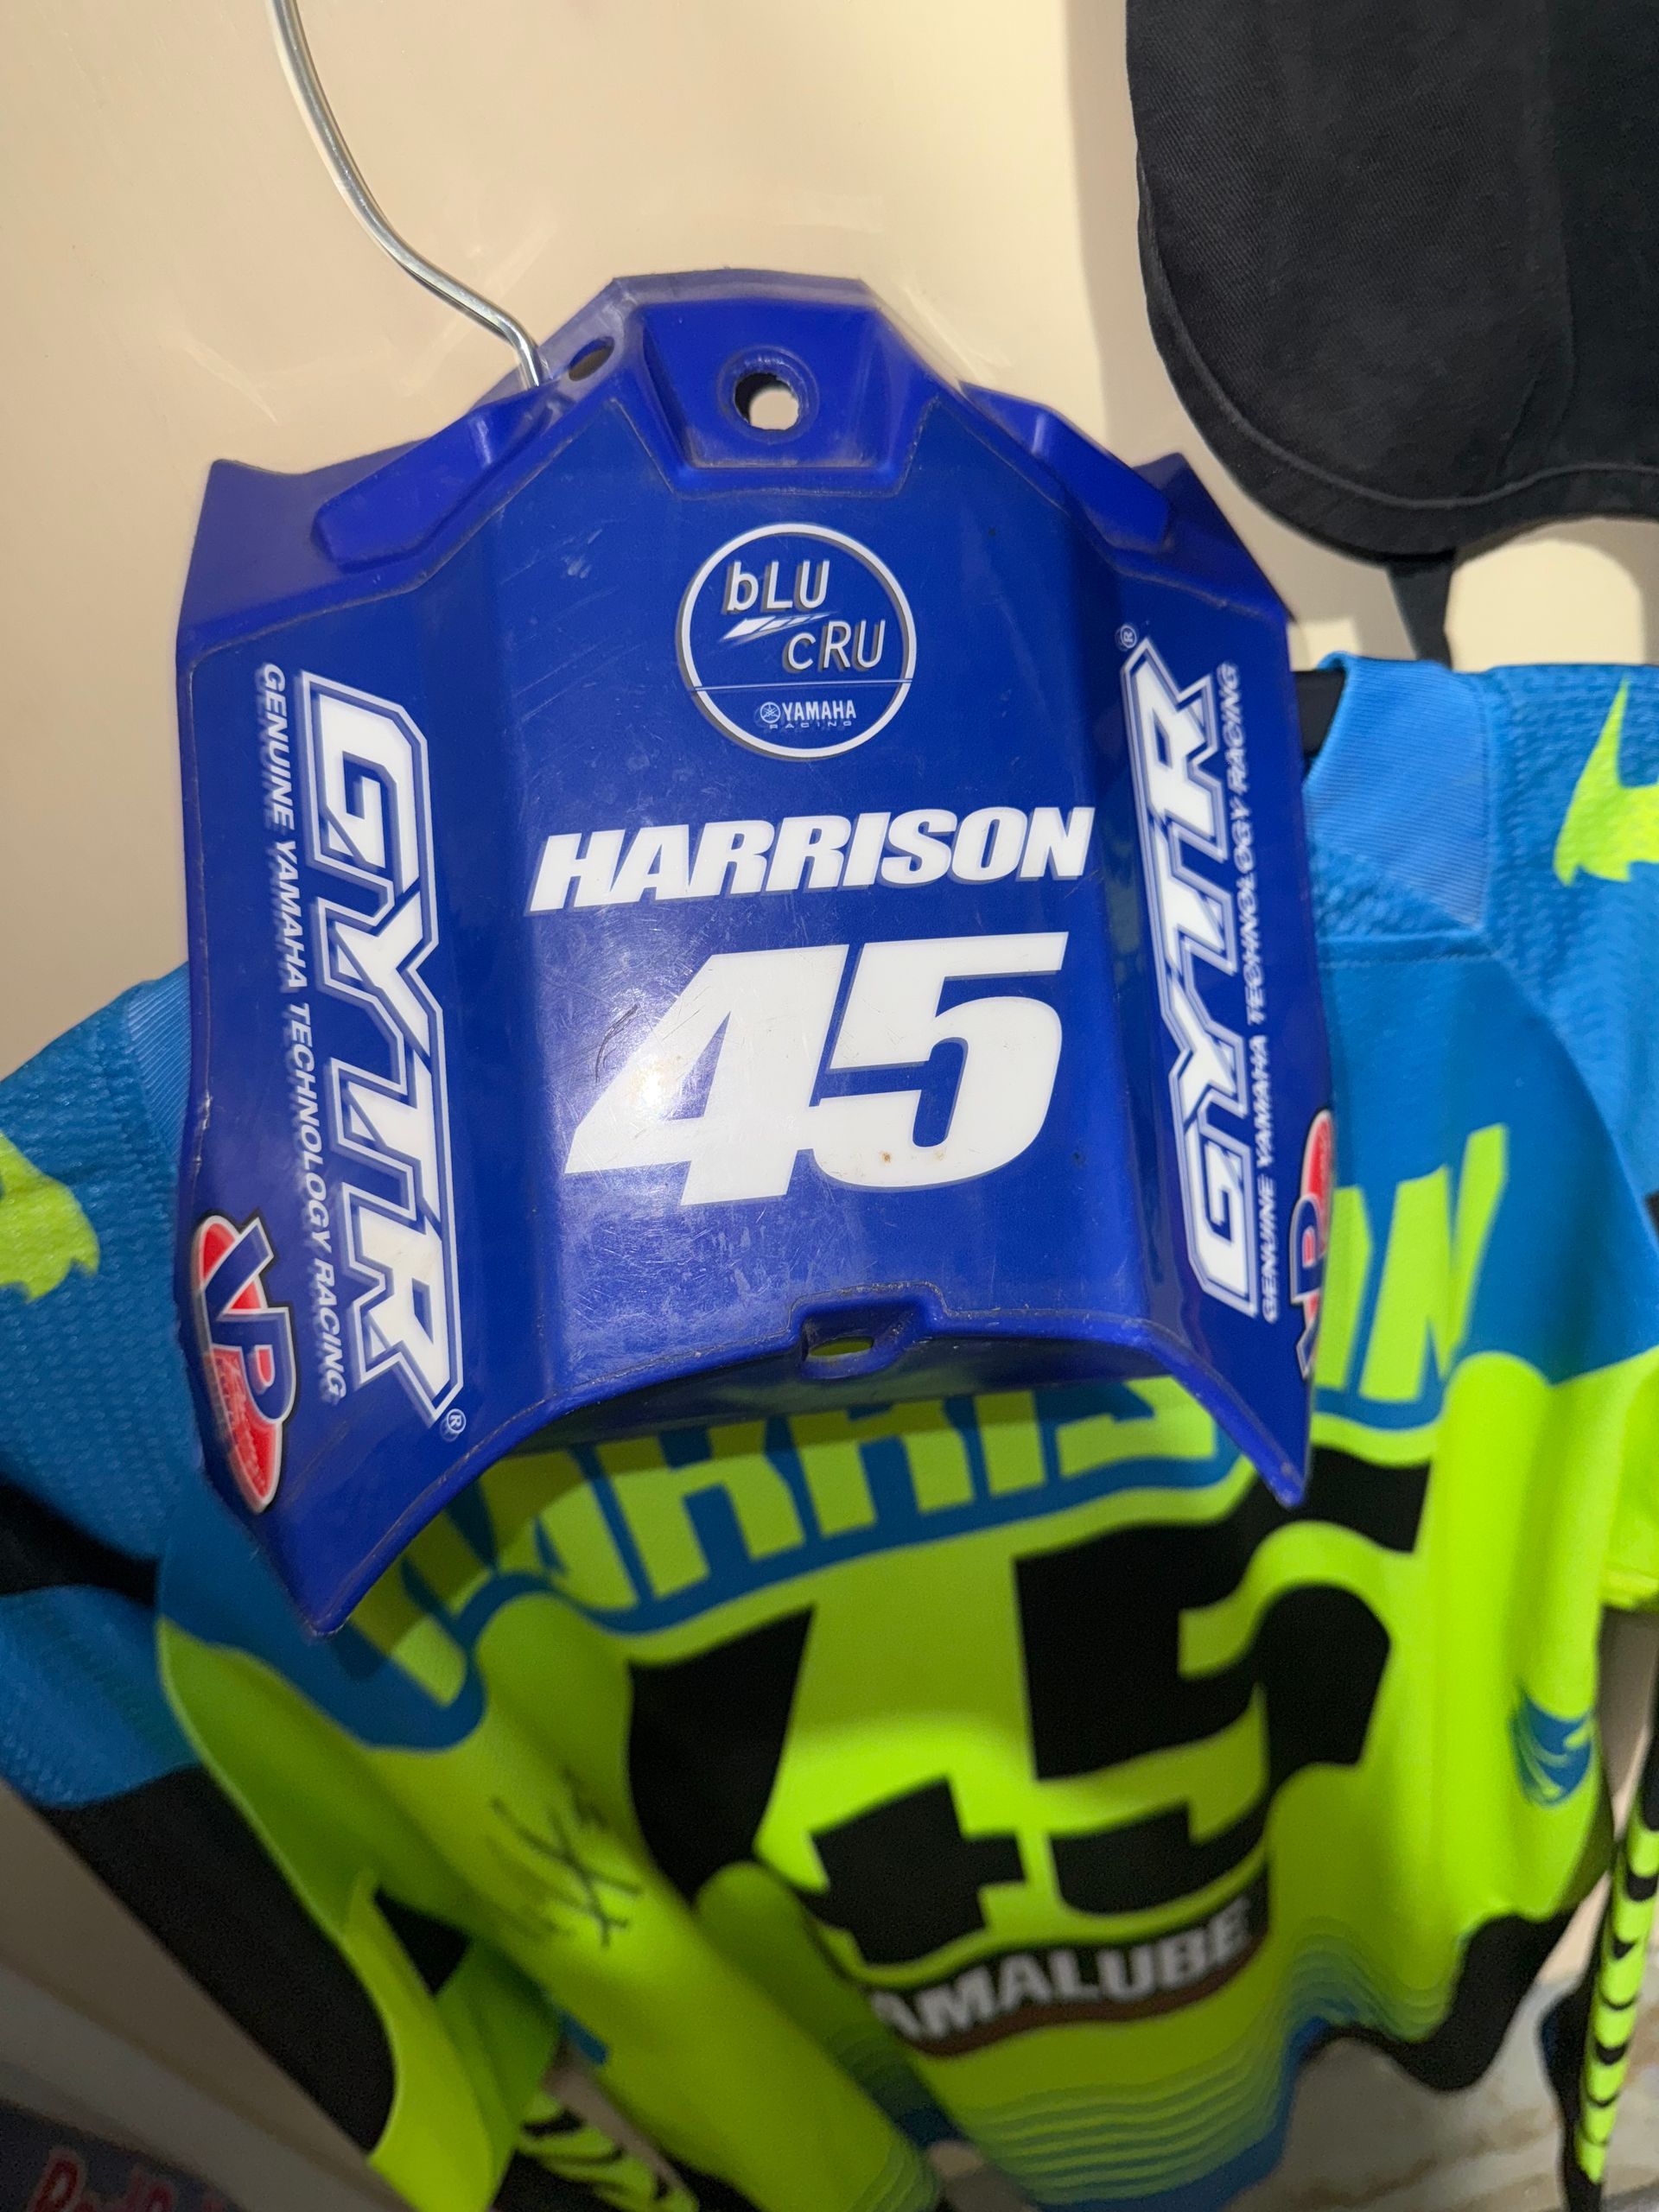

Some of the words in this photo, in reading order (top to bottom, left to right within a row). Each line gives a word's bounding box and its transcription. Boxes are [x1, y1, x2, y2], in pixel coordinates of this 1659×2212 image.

[262, 662, 295, 831] GENUINE
[769, 720, 852, 730] RACING
[781, 699, 857, 721] YAMAHA
[1216, 661, 1248, 794] RACING
[271, 839, 308, 988] YAMAHA
[528, 806, 1096, 912] HARRISON
[1230, 798, 1267, 1027] TECHNOLOGY
[289, 1002, 333, 1255] TECHNOLOGY
[563, 931, 1068, 1206] 45
[1249, 1035, 1273, 1167] YAMAHA
[1260, 1173, 1280, 1325] GENUINE
[312, 1258, 346, 1402] RACING
